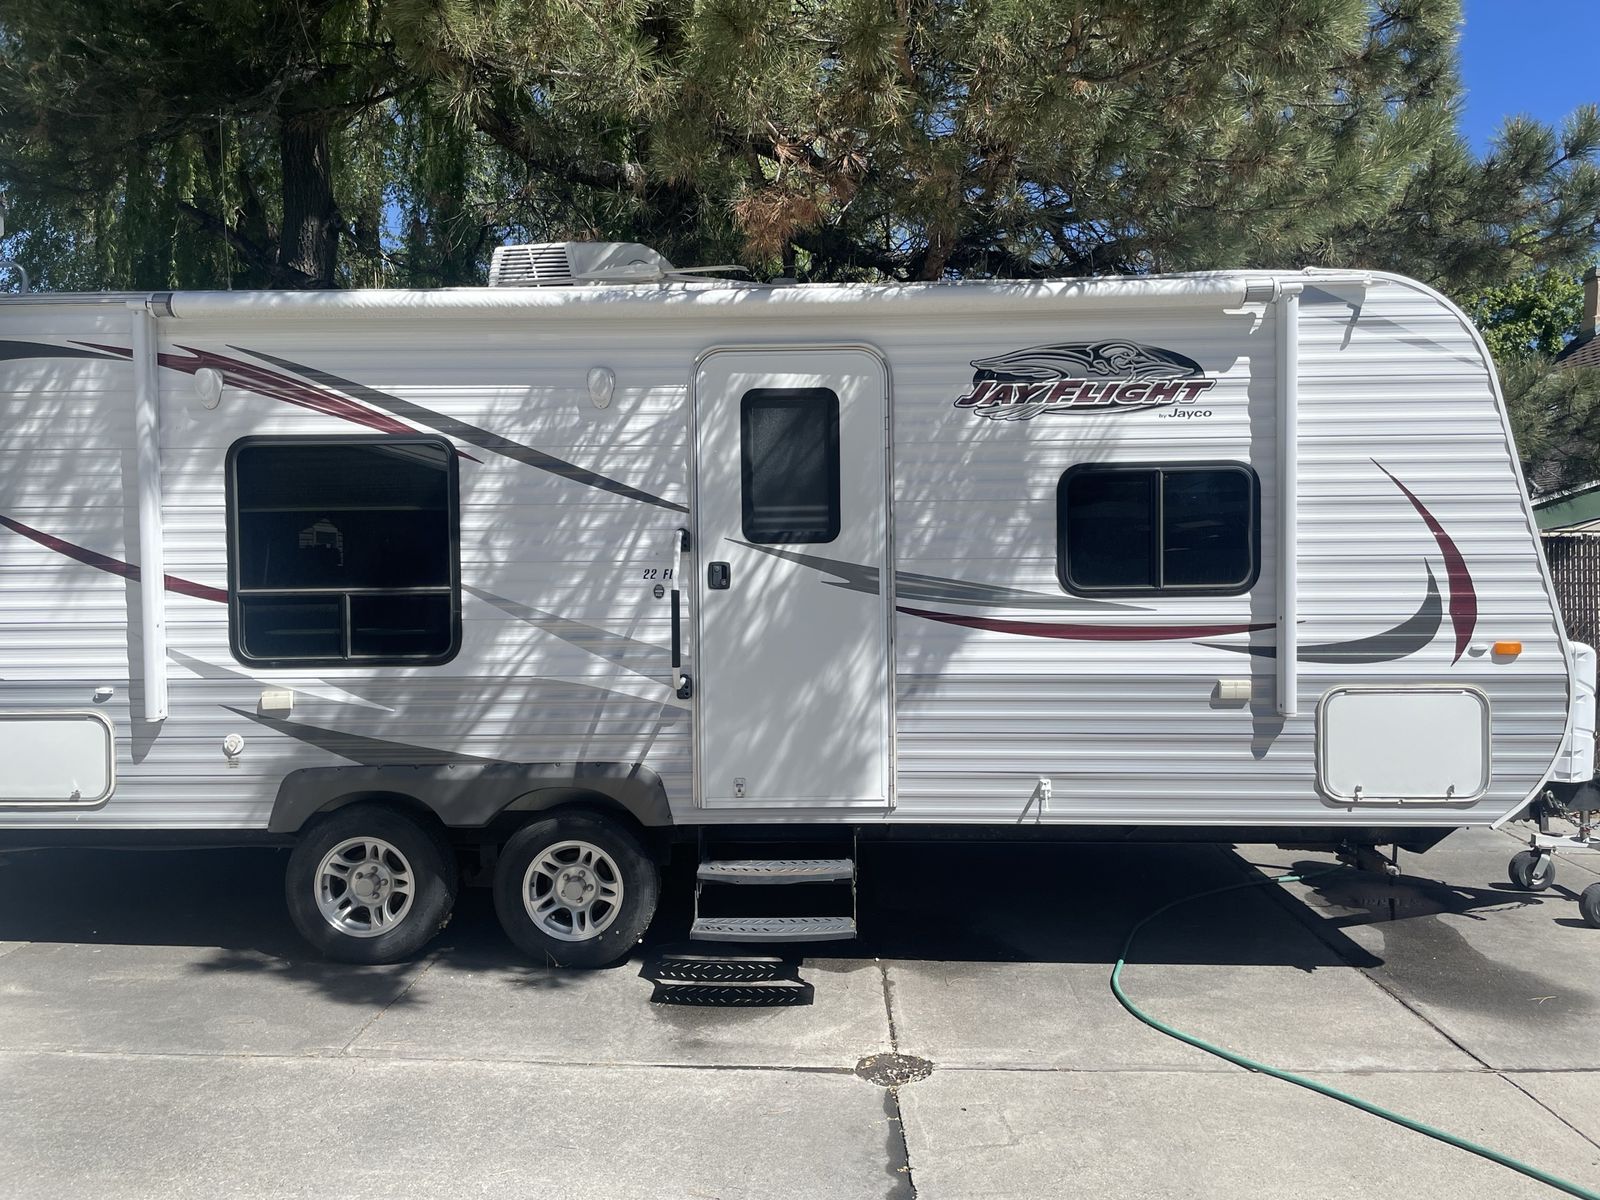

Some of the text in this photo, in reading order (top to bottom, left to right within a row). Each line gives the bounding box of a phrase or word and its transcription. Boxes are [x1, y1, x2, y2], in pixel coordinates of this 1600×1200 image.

[955, 378, 1217, 407] JAY FLIGHT
[1168, 408, 1212, 419] Jayco
[643, 568, 657, 580] 22
